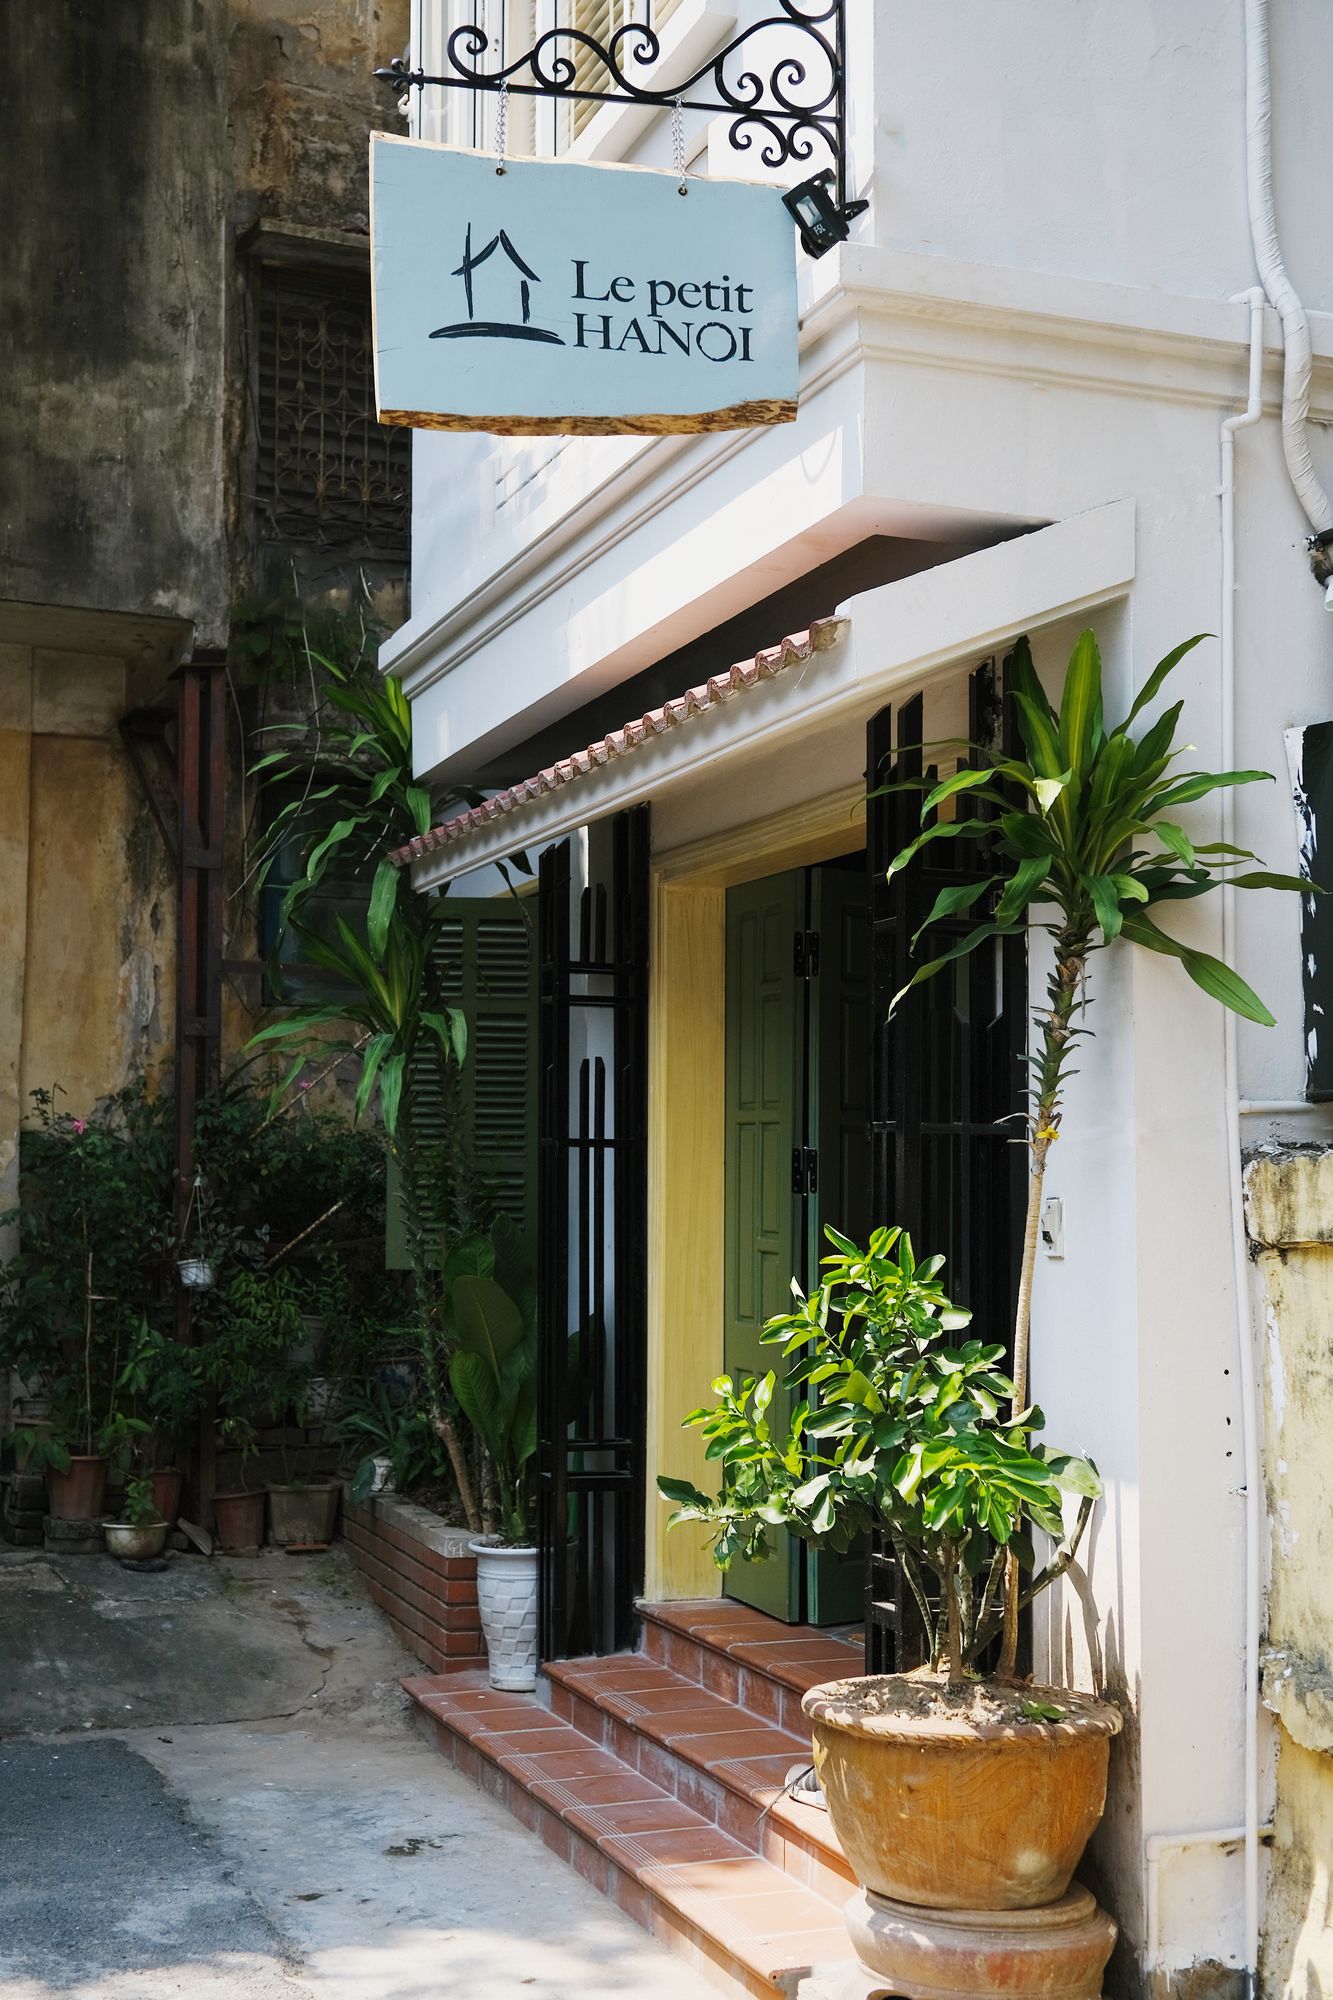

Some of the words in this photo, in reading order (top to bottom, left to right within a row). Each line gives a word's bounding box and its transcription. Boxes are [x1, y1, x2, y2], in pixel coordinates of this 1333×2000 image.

[813, 223, 826, 236] FSL
[571, 260, 636, 303] Le
[646, 275, 754, 318] petit
[572, 312, 755, 363] HANOI
